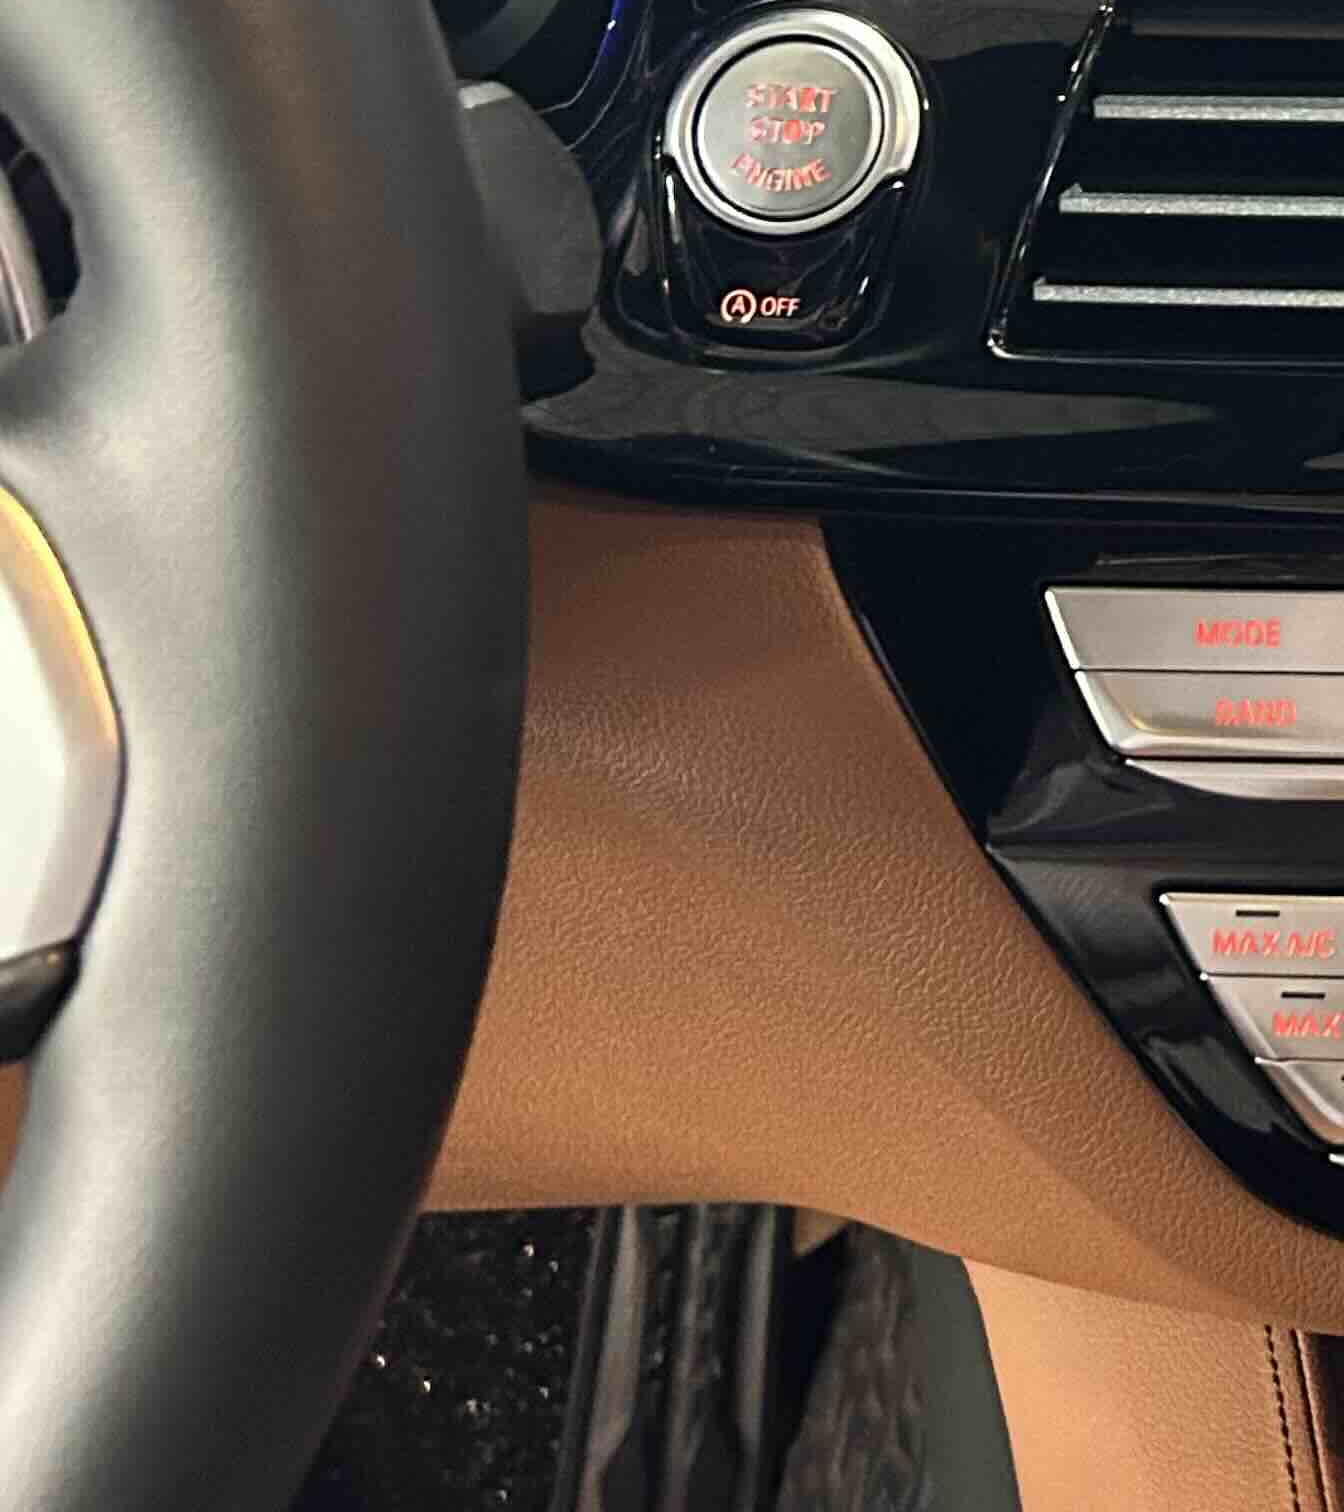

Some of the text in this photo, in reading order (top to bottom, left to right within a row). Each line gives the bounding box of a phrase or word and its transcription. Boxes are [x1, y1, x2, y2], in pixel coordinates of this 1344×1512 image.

[746, 82, 836, 113] START
[750, 115, 826, 144] STOP
[760, 296, 801, 317] OFF
[1193, 618, 1282, 649] MODE
[1211, 930, 1280, 955] MAX
[1272, 1012, 1343, 1039] MAX
